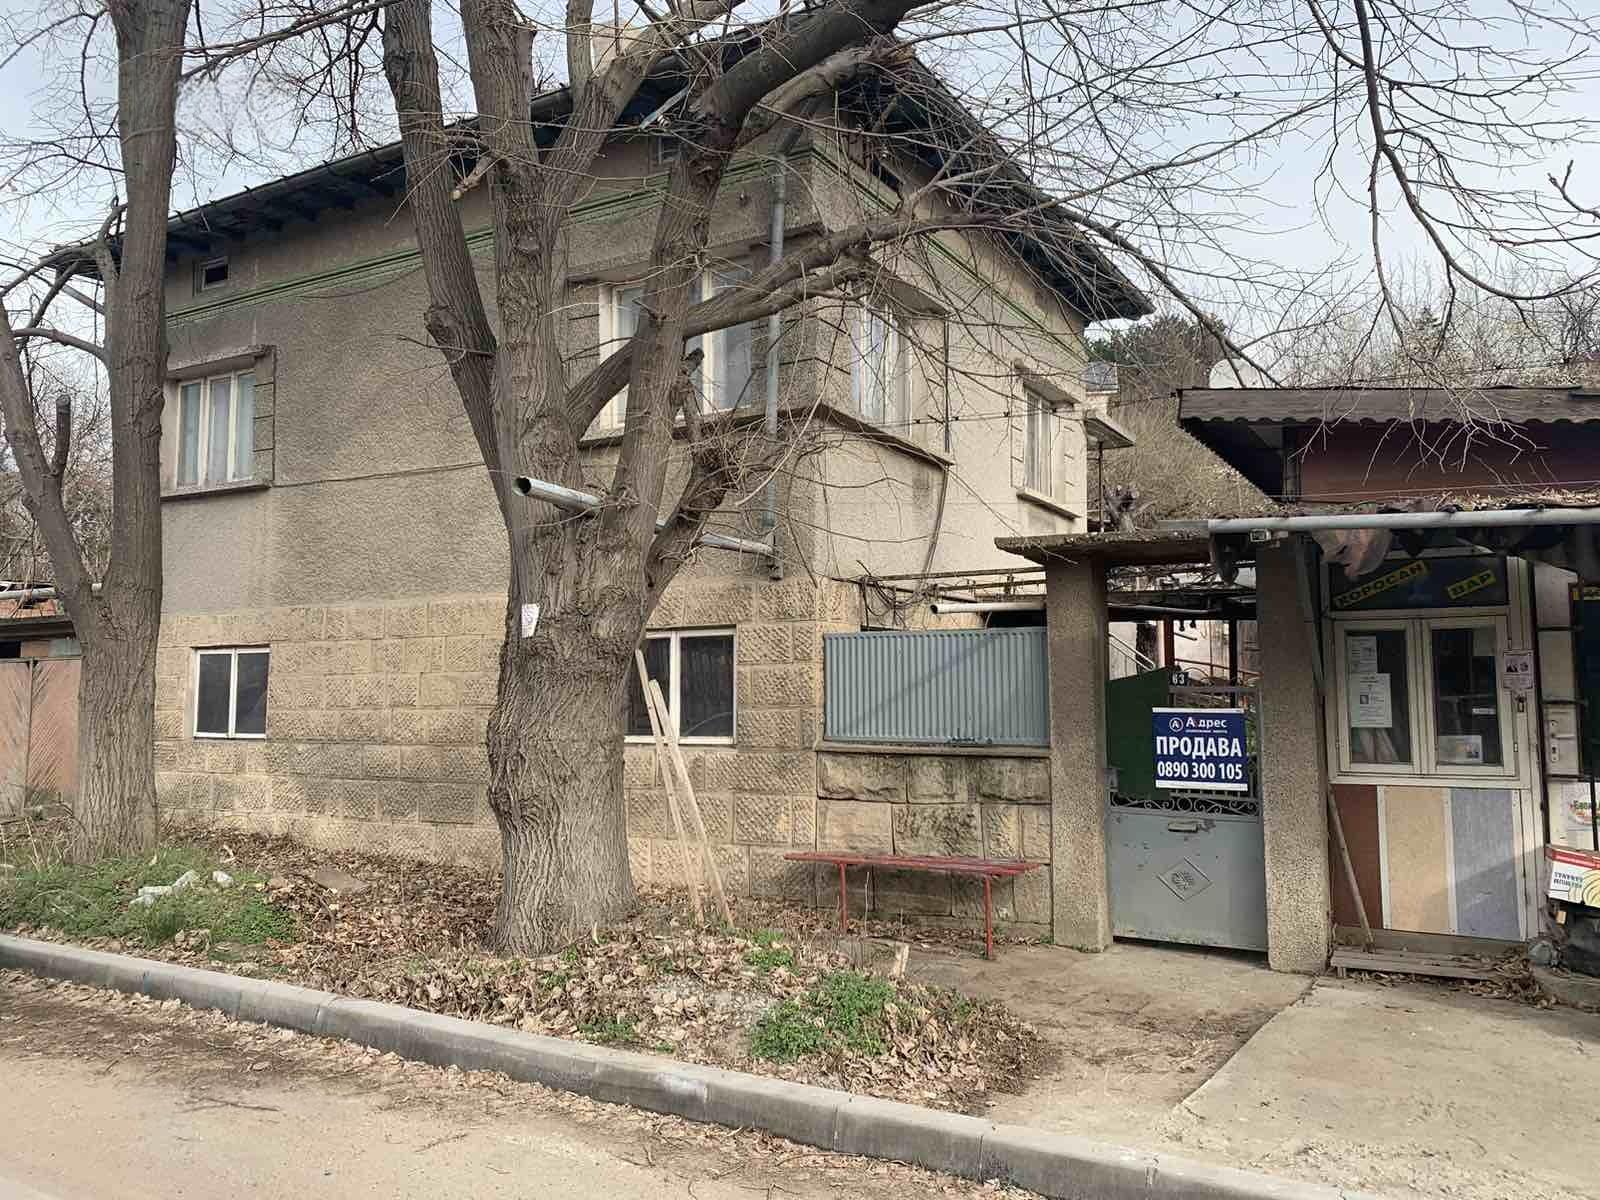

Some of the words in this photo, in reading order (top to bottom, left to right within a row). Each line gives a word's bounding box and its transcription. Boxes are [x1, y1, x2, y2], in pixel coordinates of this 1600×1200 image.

[1156, 736, 1242, 760] ПРОДАВА
[1157, 761, 1189, 778] 0890
[1191, 763, 1216, 779] 300
[1219, 764, 1243, 780] 105
